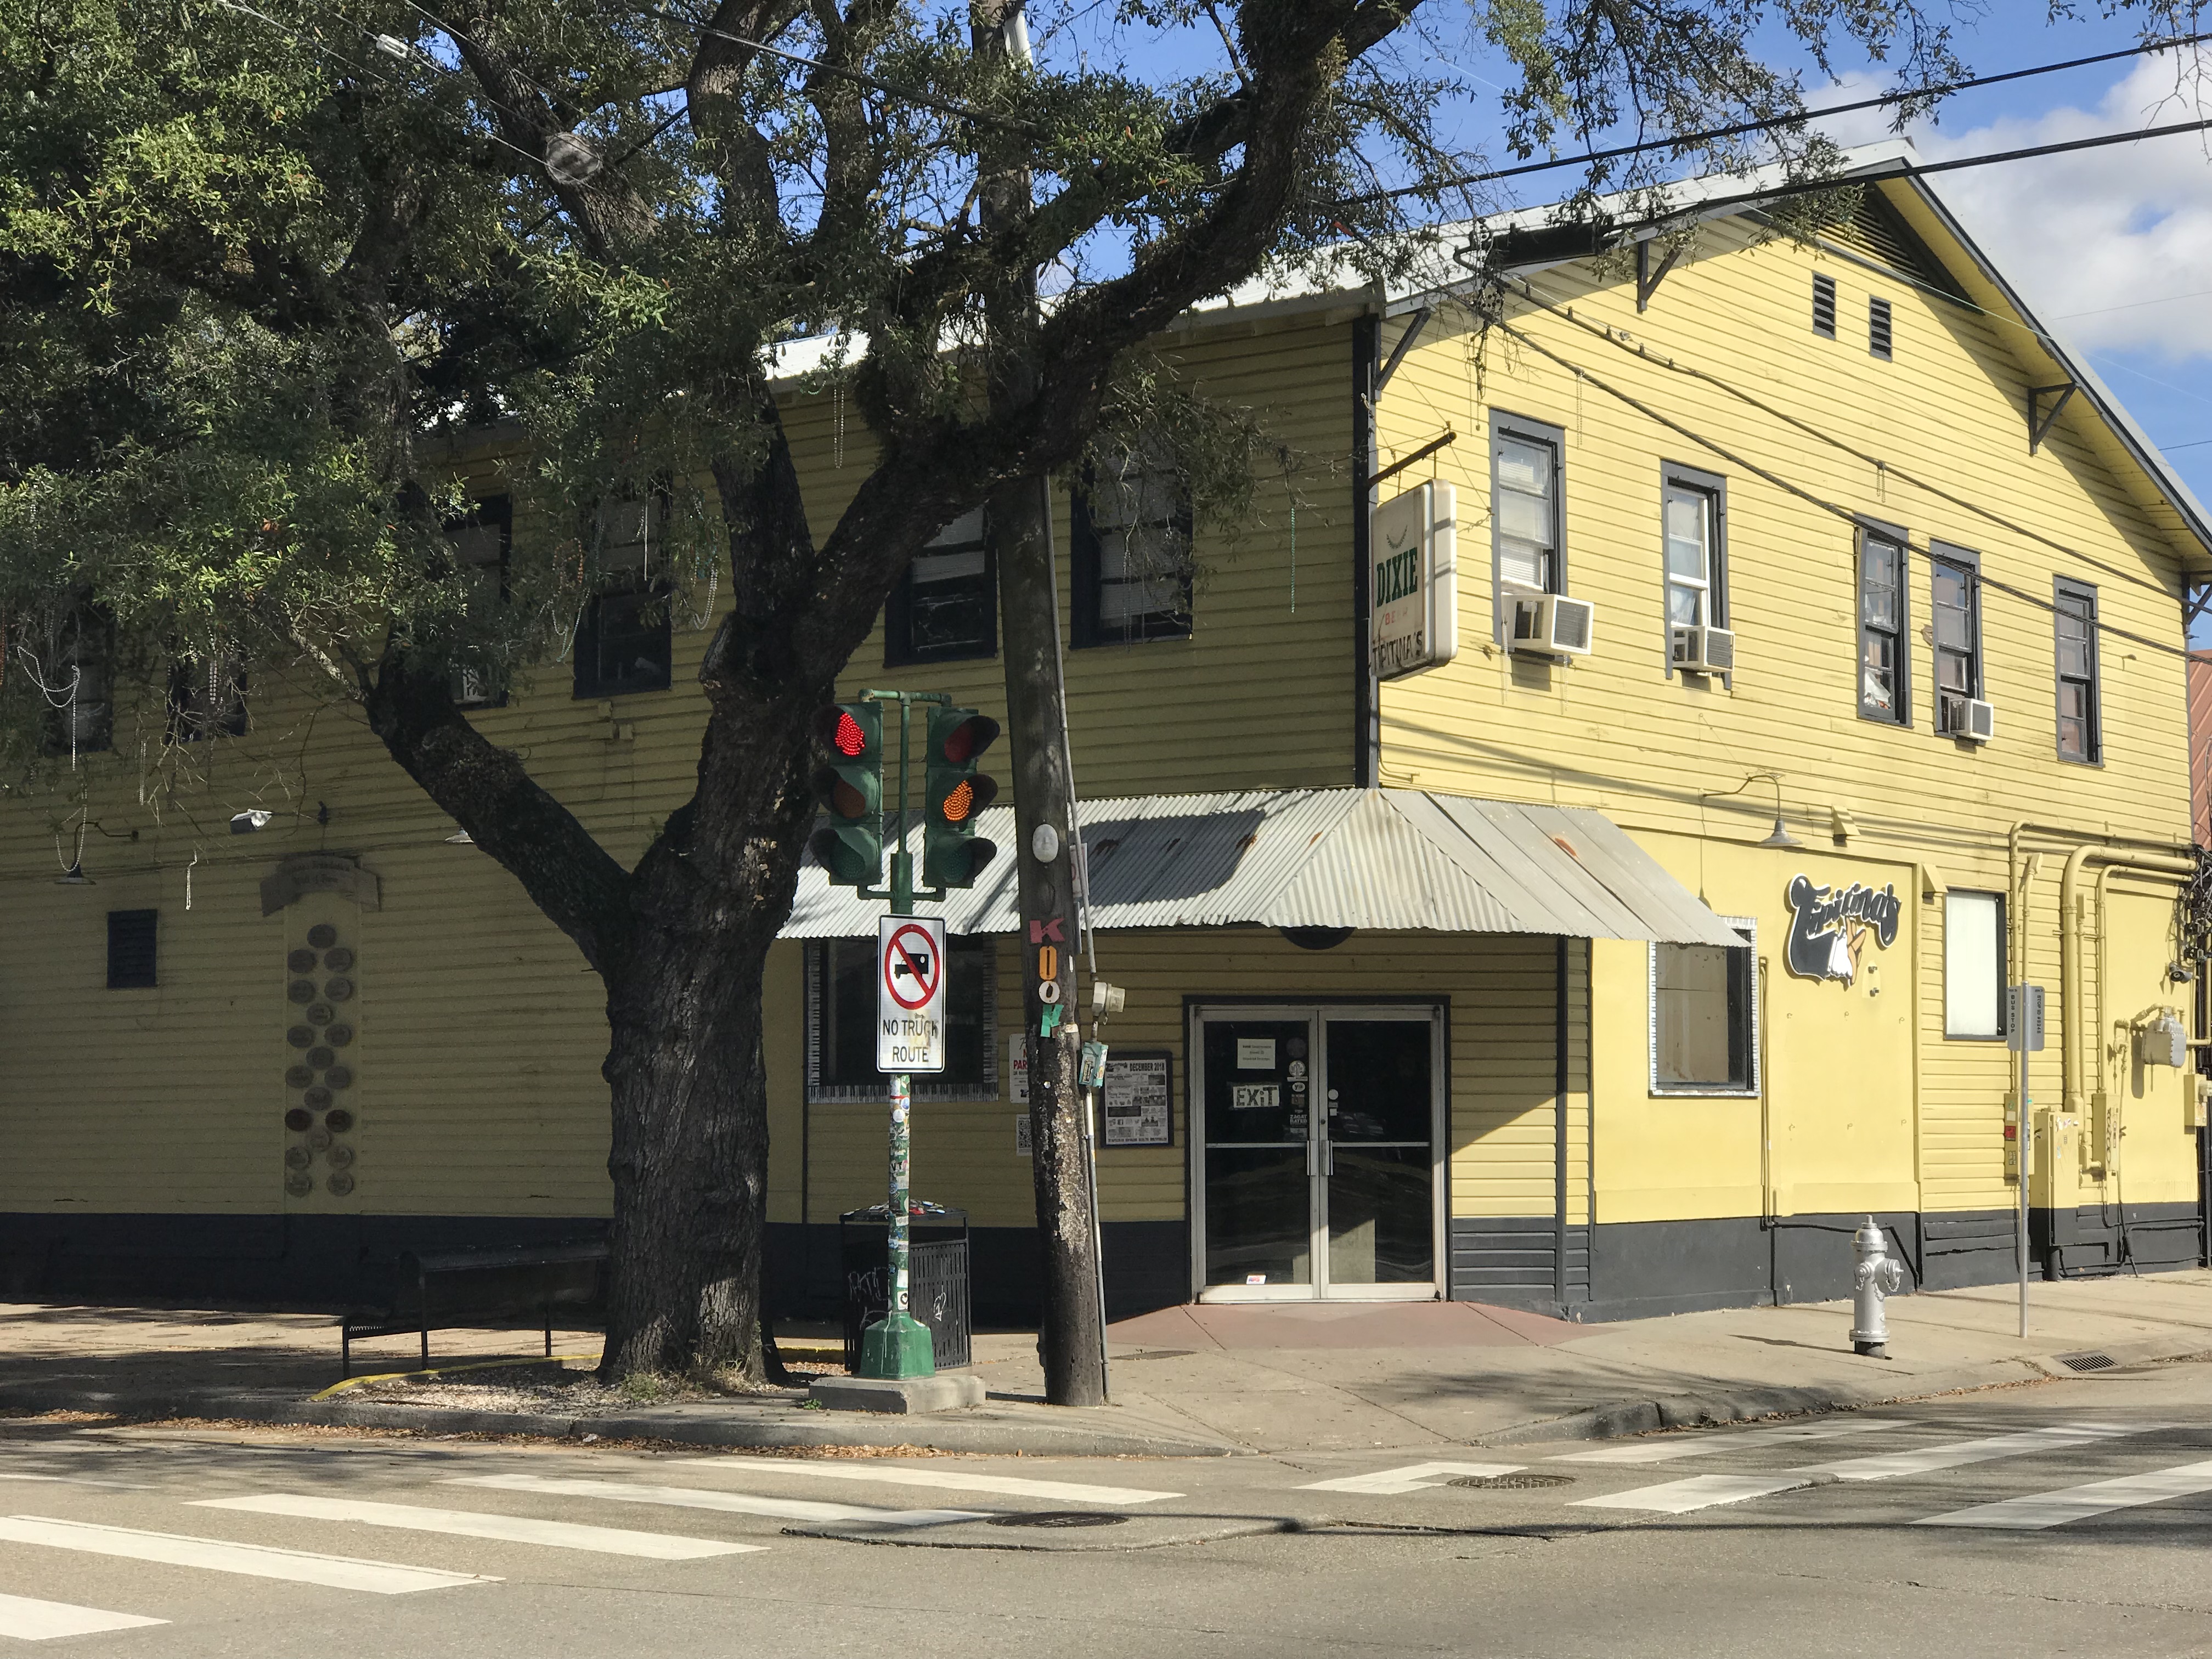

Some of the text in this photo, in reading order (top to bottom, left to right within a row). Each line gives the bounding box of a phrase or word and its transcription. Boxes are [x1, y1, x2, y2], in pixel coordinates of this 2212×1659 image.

[1376, 547, 1418, 608] DIXIE
[1385, 607, 1408, 625] BER
[1372, 630, 1423, 672] TIPITINA'S
[883, 1019, 938, 1037] NO TRUCK
[893, 1046, 929, 1063] ROUTE
[1130, 1063, 1153, 1071] DECEMBER
